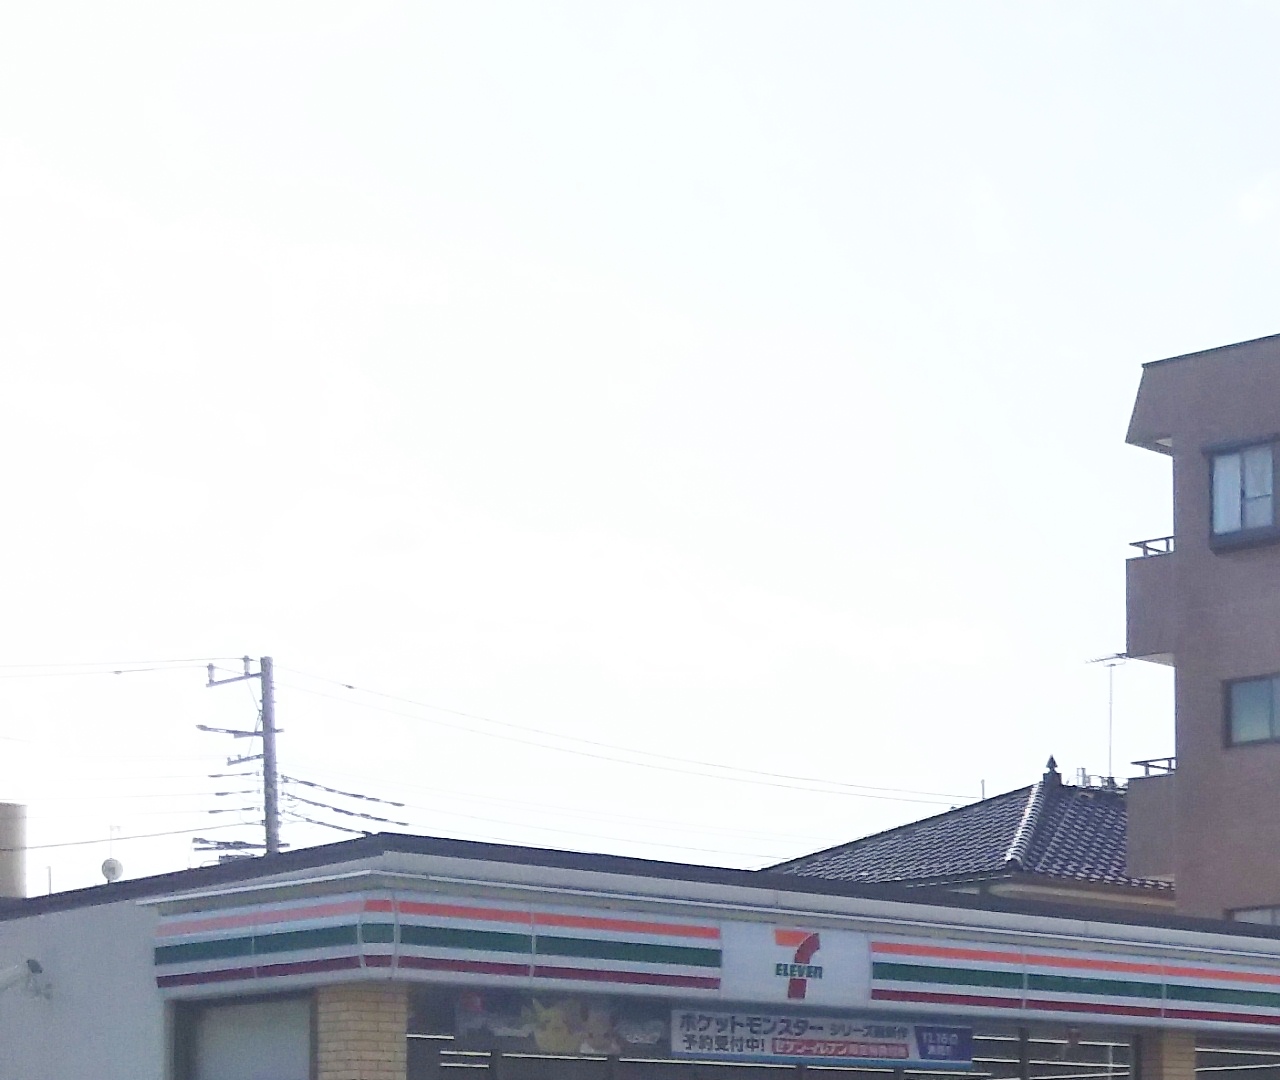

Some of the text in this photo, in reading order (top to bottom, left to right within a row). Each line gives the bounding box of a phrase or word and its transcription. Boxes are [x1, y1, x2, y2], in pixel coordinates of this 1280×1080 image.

[775, 929, 820, 999] 7
[680, 1014, 824, 1036] ポケットモンスター
